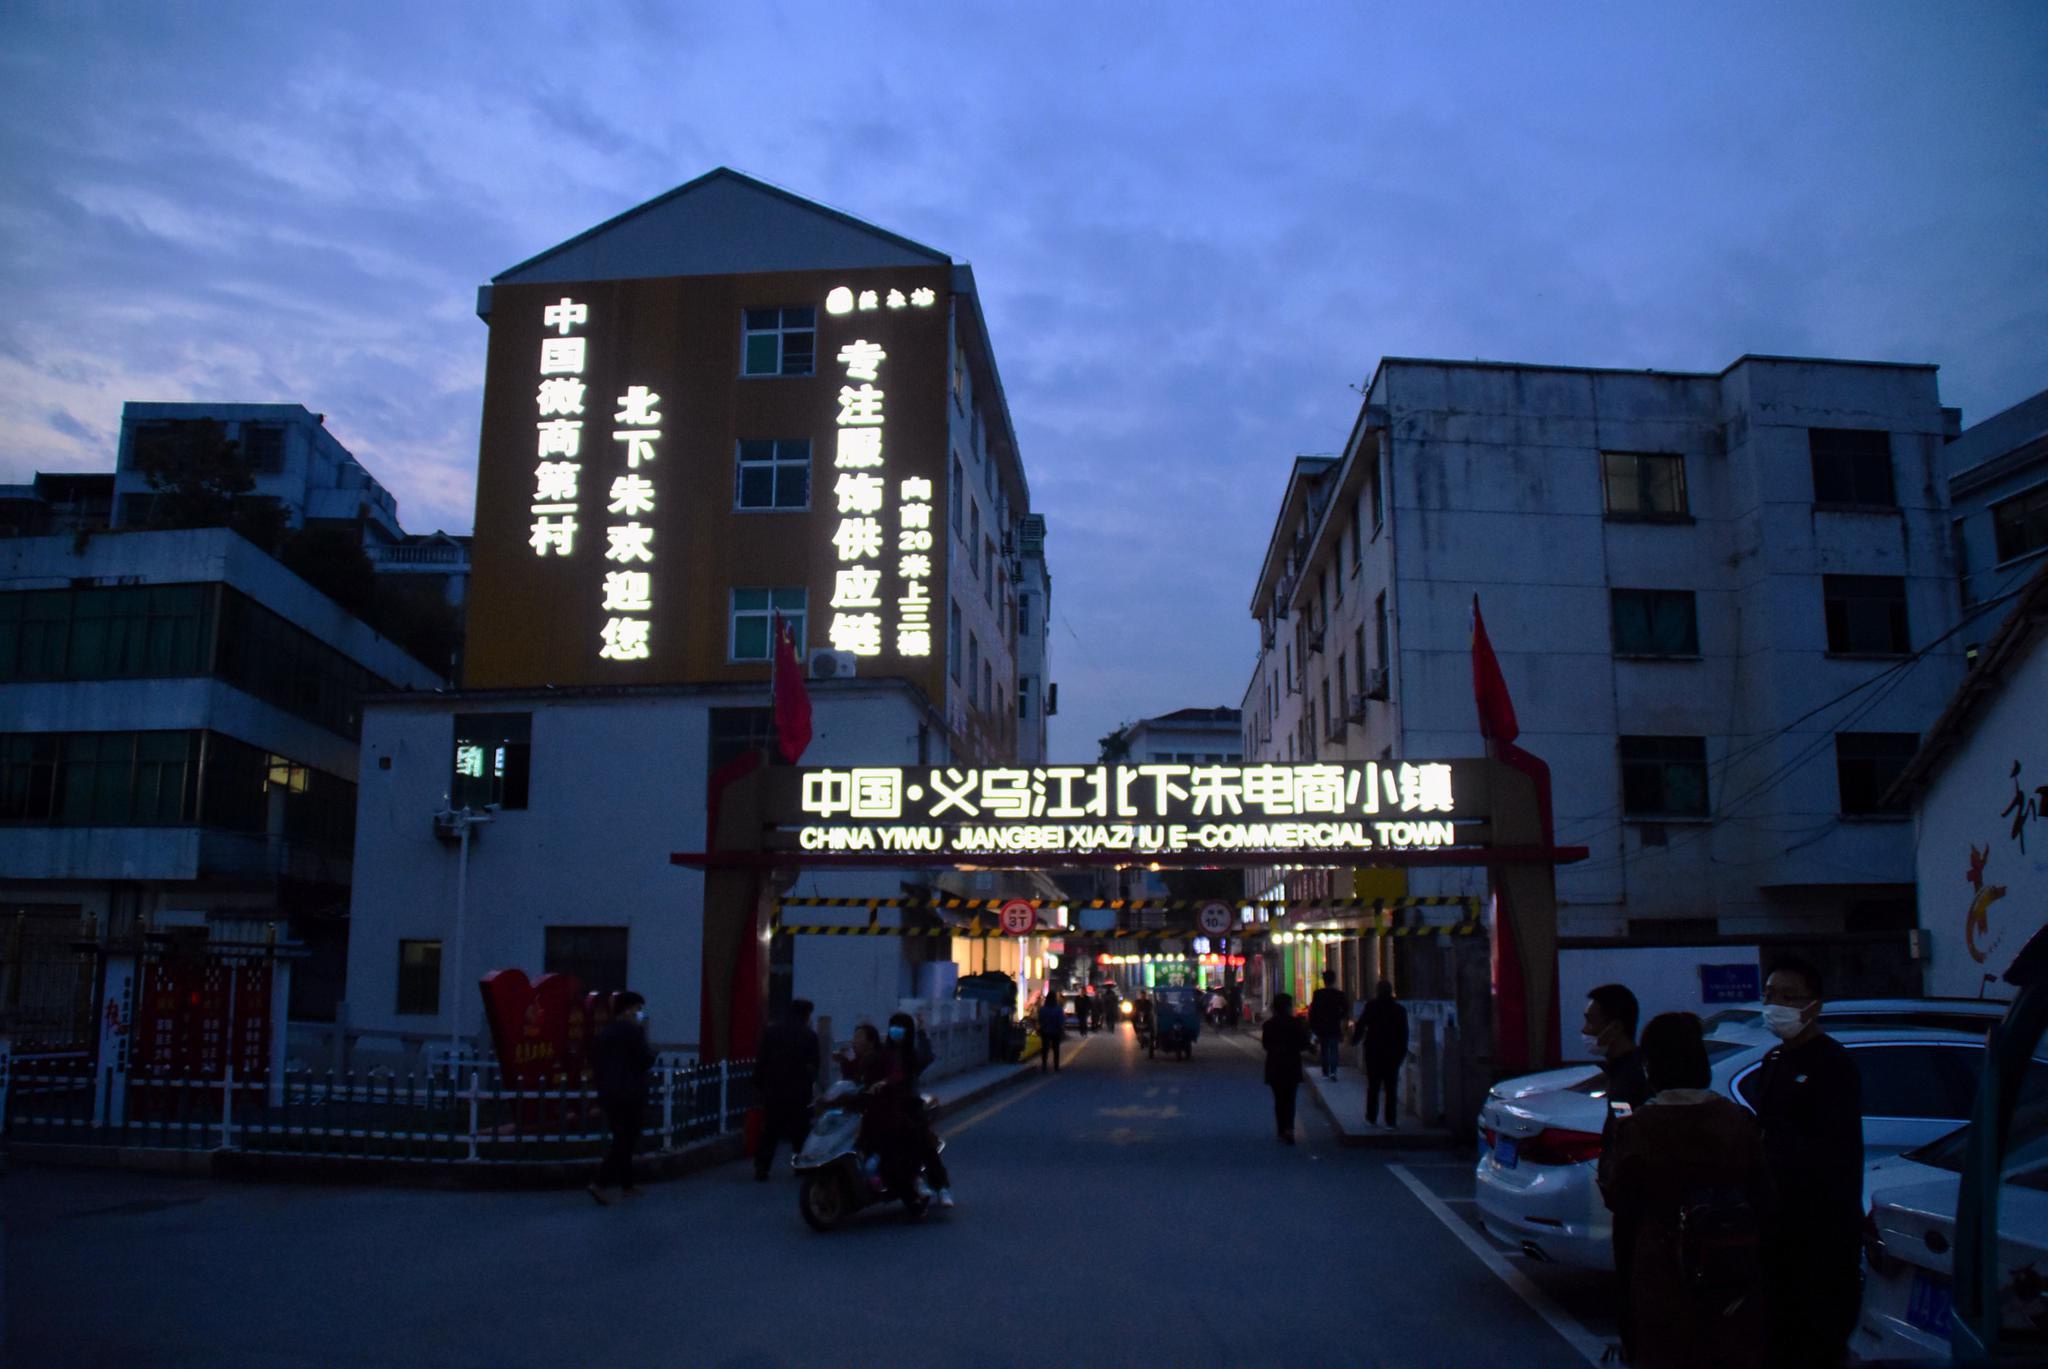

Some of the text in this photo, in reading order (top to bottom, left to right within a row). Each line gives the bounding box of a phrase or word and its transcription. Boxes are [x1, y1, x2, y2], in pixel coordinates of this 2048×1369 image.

[529, 298, 587, 556] 中国微商第一村
[600, 385, 661, 660] 北下朱欢迎您
[829, 339, 886, 656] 专注服饰供应链
[799, 827, 875, 851] CHINA
[876, 826, 943, 850] YIWU
[951, 825, 1064, 850] JIANGBEI
[1168, 822, 1373, 849] E-COMMERCIAL
[1375, 821, 1454, 847] TOWN
